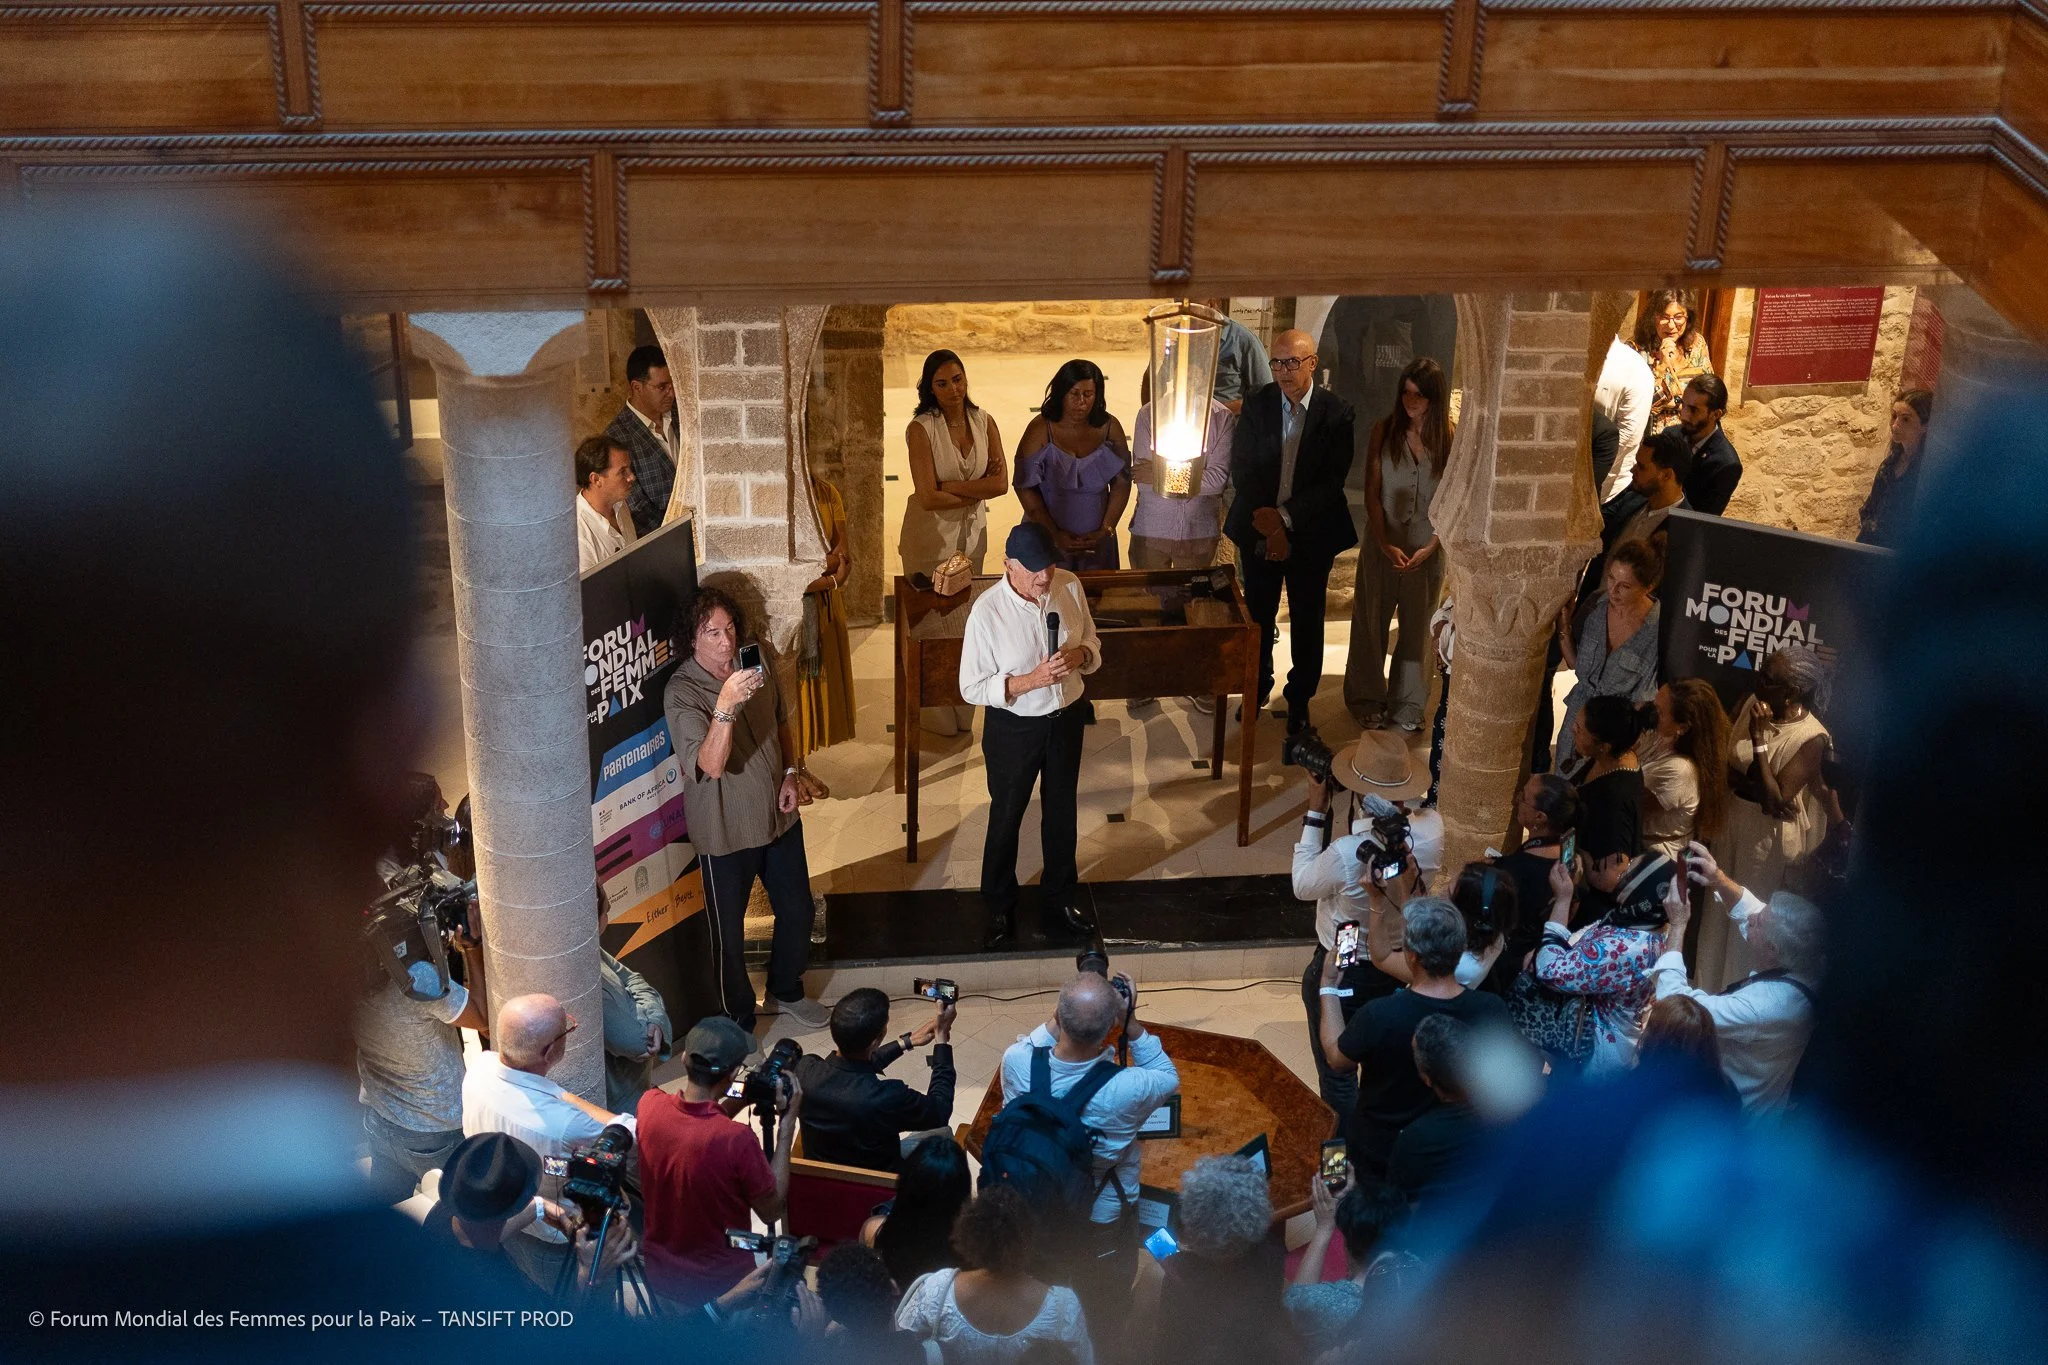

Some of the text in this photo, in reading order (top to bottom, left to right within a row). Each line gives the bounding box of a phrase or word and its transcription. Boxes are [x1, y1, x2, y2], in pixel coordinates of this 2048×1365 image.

[1702, 582, 1810, 621] FORUM
[1685, 597, 1824, 645] MONDIAL
[584, 629, 658, 686] ONDIAL
[1698, 645, 1718, 653] POUR
[1717, 644, 1764, 672] PAI
[590, 686, 600, 696] DES
[597, 679, 644, 724] PAIX
[586, 710, 597, 720] OUR
[620, 797, 636, 810] BANK
[637, 792, 645, 800] OF
[647, 780, 666, 796] AFRICA
